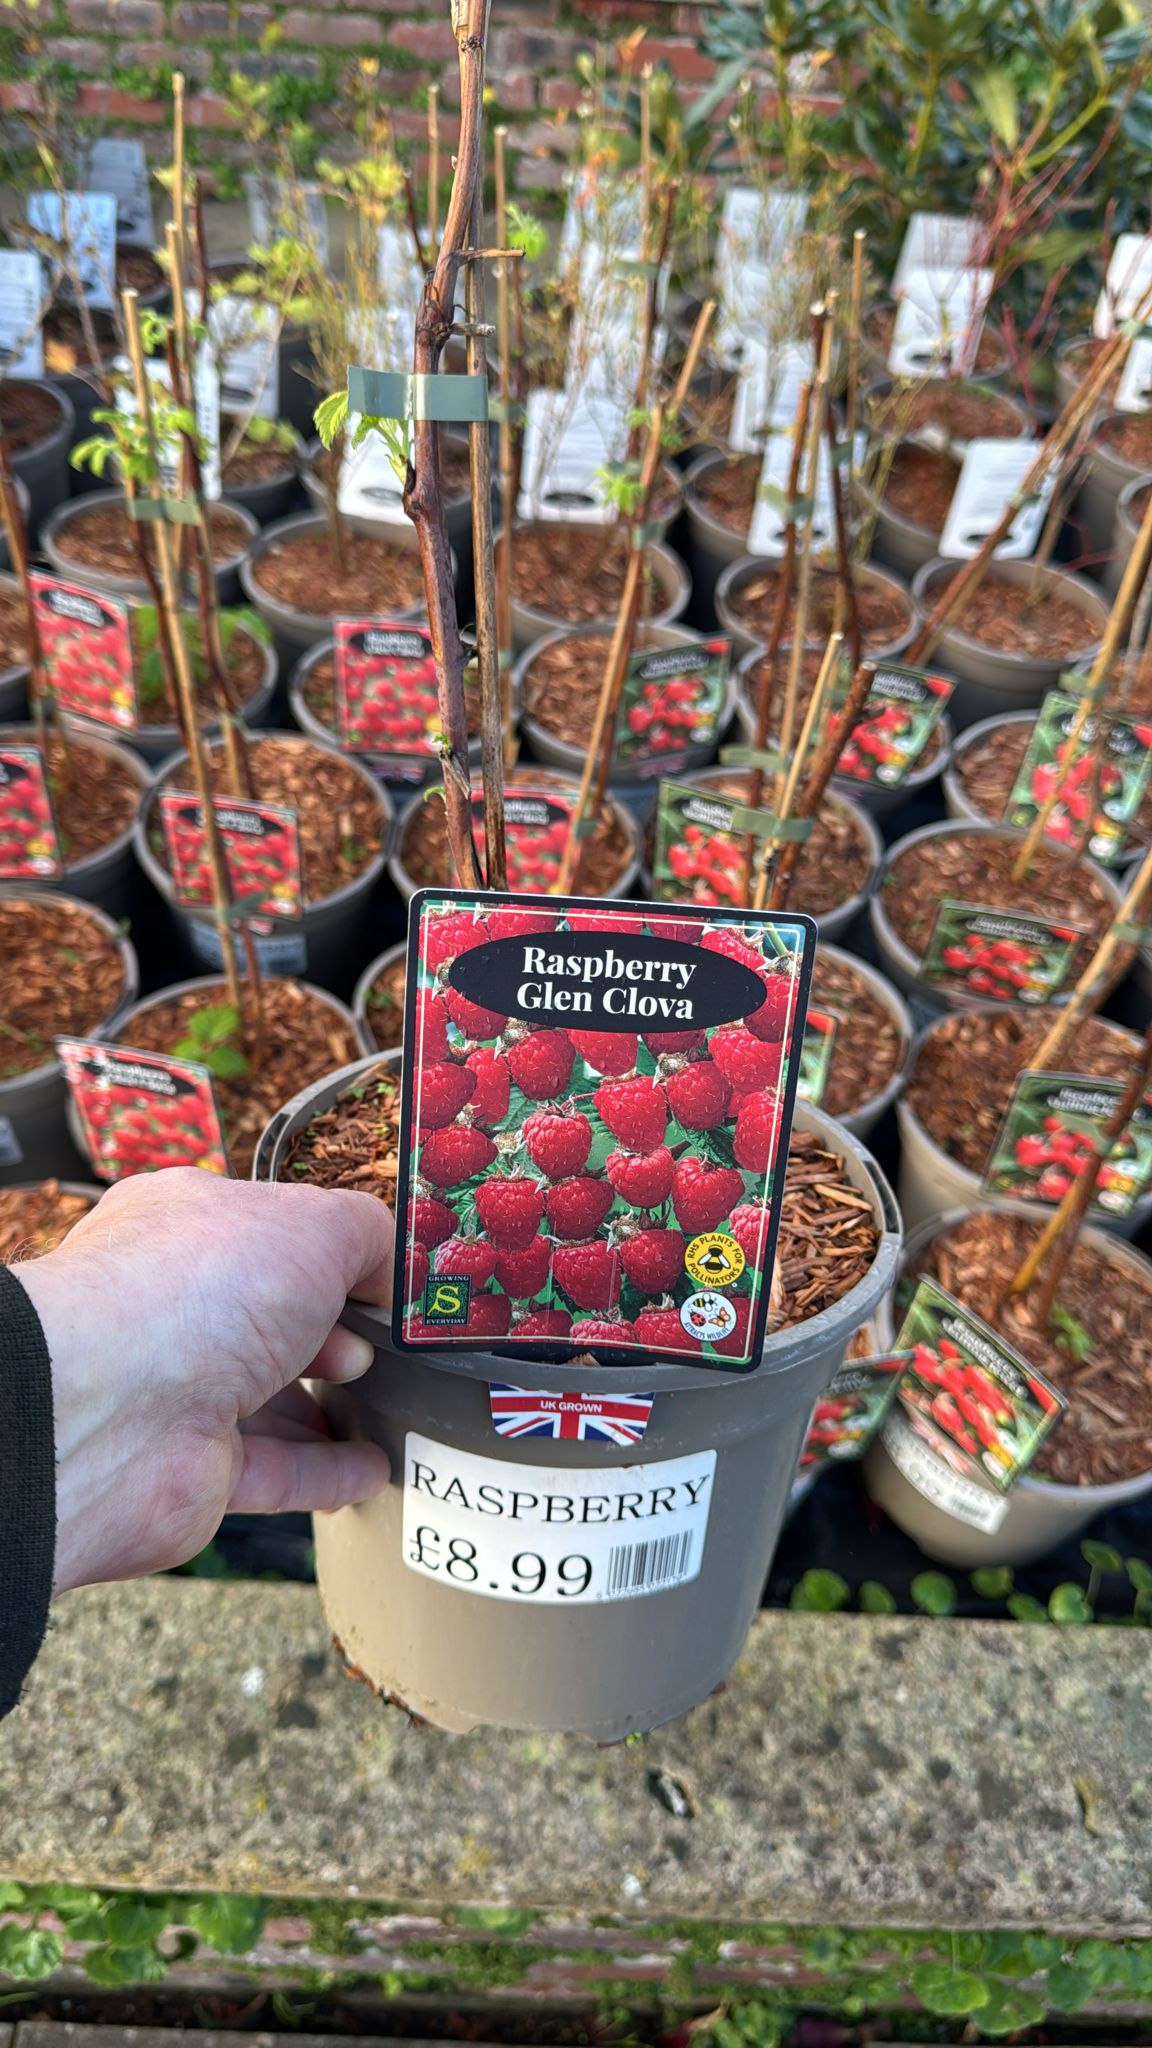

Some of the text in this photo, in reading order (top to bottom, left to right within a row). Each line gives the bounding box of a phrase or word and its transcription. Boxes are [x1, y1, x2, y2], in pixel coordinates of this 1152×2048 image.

[522, 946, 697, 990] Raspberry
[516, 982, 695, 1020] Glen Clova
[687, 1235, 743, 1264] RHS PLANTS FOR
[688, 1262, 741, 1285] POLLINATORS
[427, 1285, 461, 1317] S
[684, 1322, 730, 1341] ATTRACTS WILDLIFE
[540, 1400, 603, 1413] UK GROWN
[410, 1459, 710, 1523] RASPBERRY
[409, 1525, 593, 1596] £8.99
